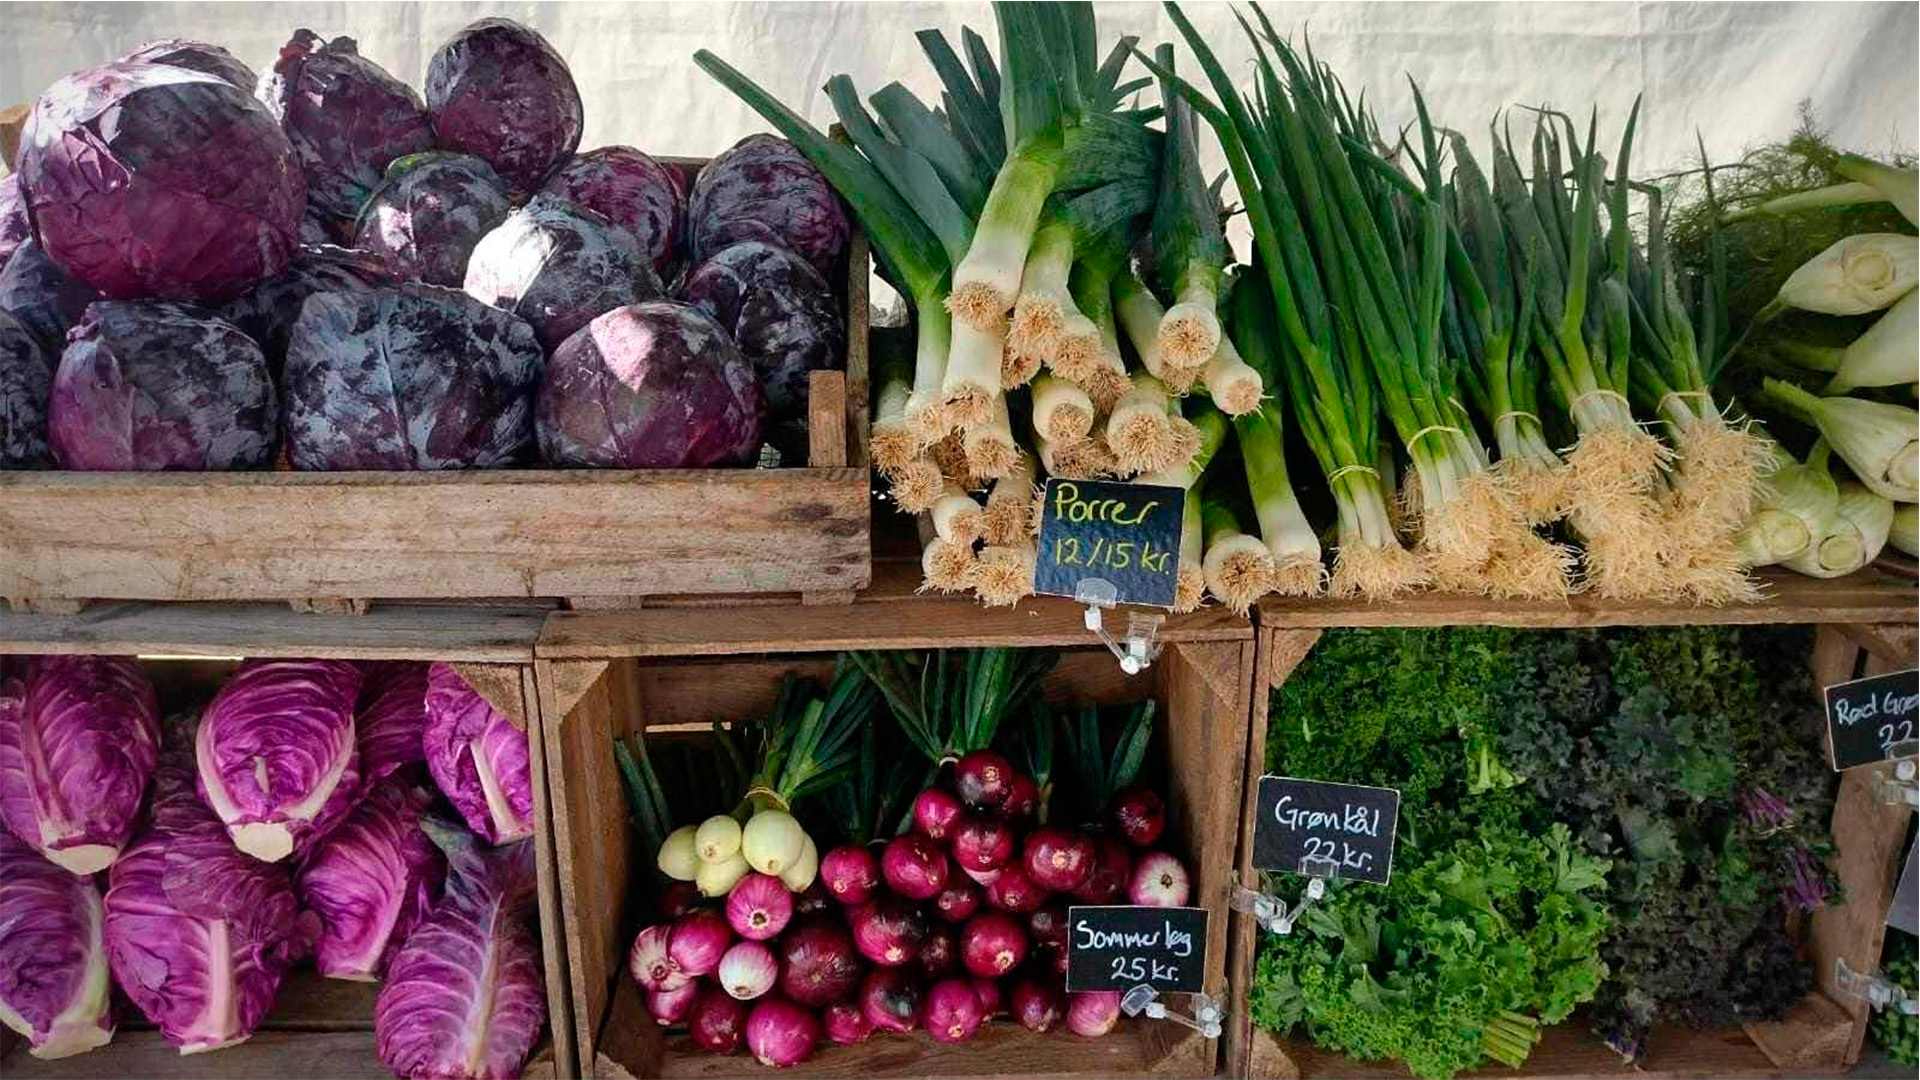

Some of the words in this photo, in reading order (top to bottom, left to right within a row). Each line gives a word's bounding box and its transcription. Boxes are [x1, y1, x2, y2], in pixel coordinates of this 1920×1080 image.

[1055, 482, 1160, 525] Porrer
[1140, 540, 1171, 576] kr.
[1274, 795, 1380, 838] Grønkål
[1303, 836, 1336, 864] 22
[1342, 842, 1373, 873] kr.
[1110, 956, 1147, 981] 25
[1151, 958, 1180, 982] kr.
